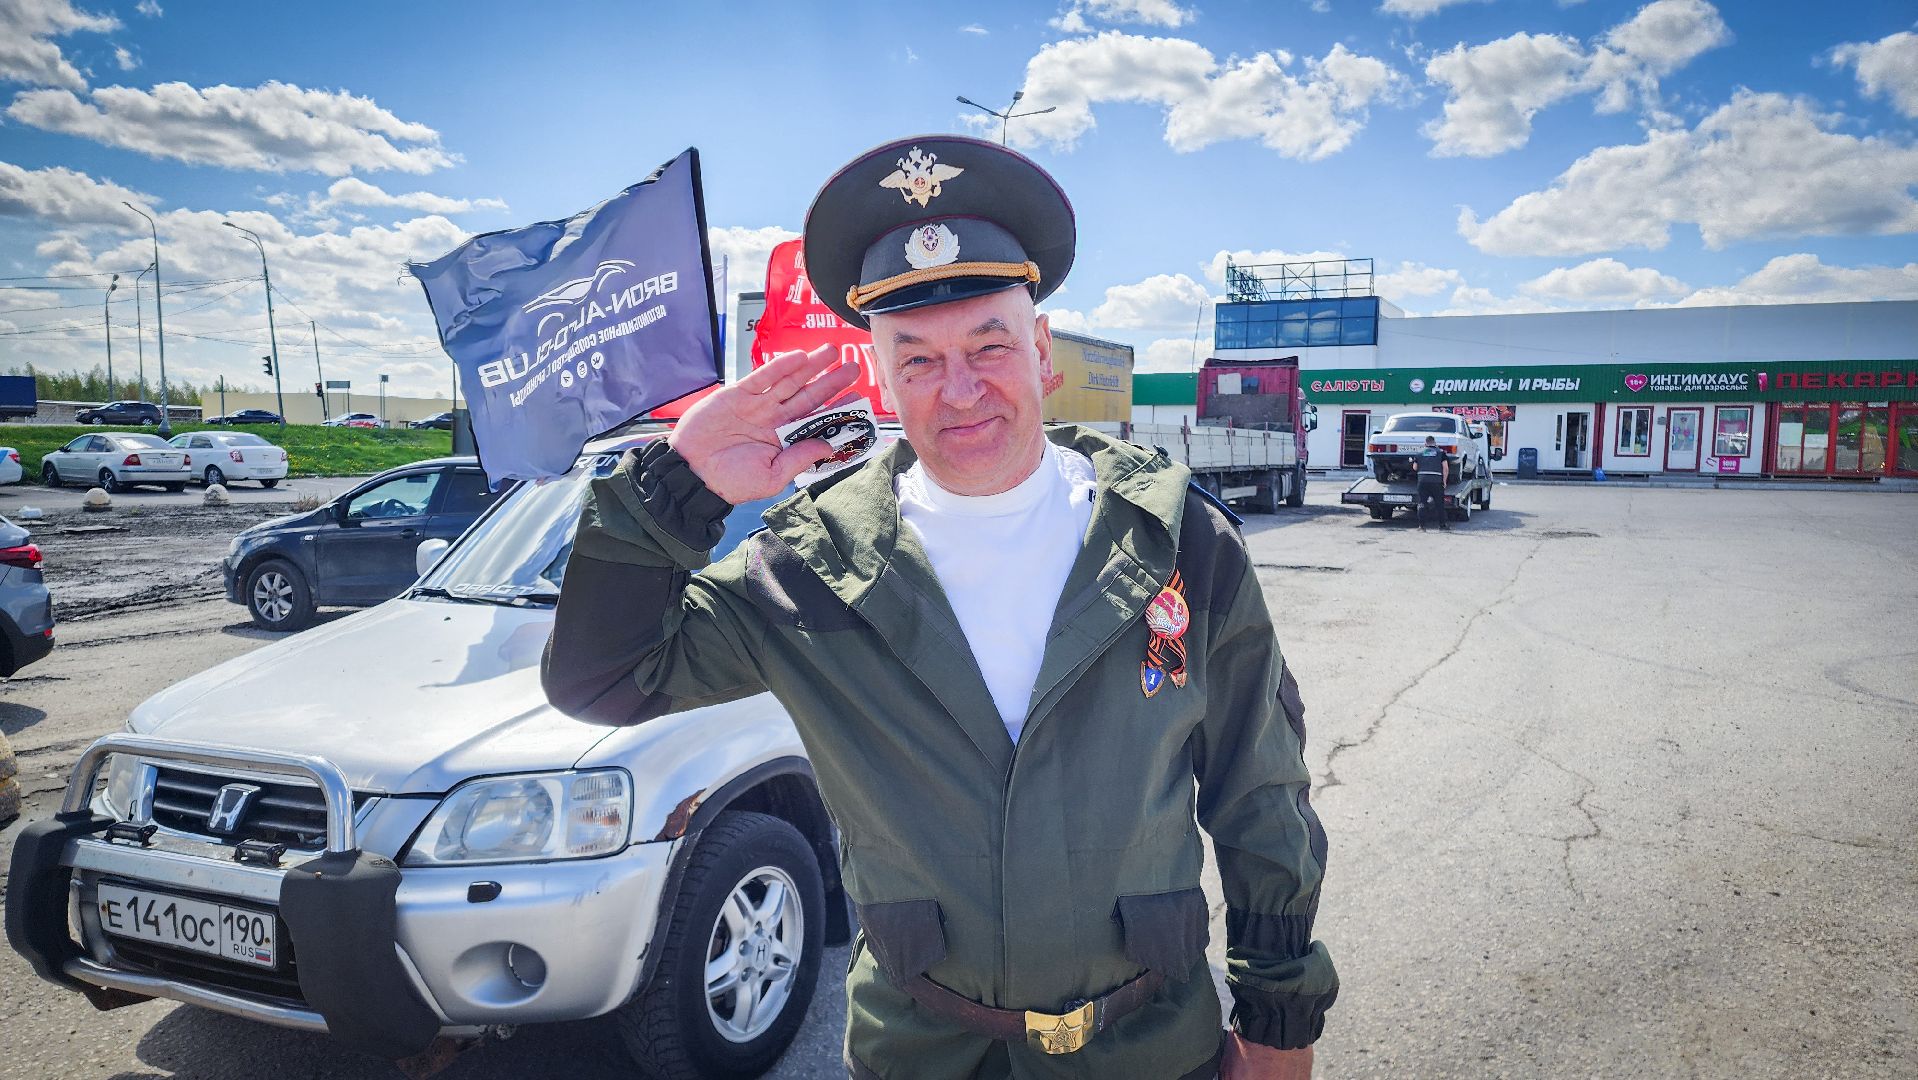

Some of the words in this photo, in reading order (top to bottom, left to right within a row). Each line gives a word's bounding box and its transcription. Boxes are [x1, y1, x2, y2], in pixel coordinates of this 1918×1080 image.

[1431, 379, 1469, 394] ДОМ
[1470, 378, 1512, 392] ИКРЫ
[1518, 379, 1531, 391] И
[1532, 377, 1580, 391] РЫБЫ
[1650, 373, 1749, 385] ИНТИМХАУС
[1311, 380, 1385, 392] САЛЮТЫ
[1453, 407, 1498, 416] РЫБА
[223, 911, 265, 946] 190
[233, 943, 255, 958] RUS
